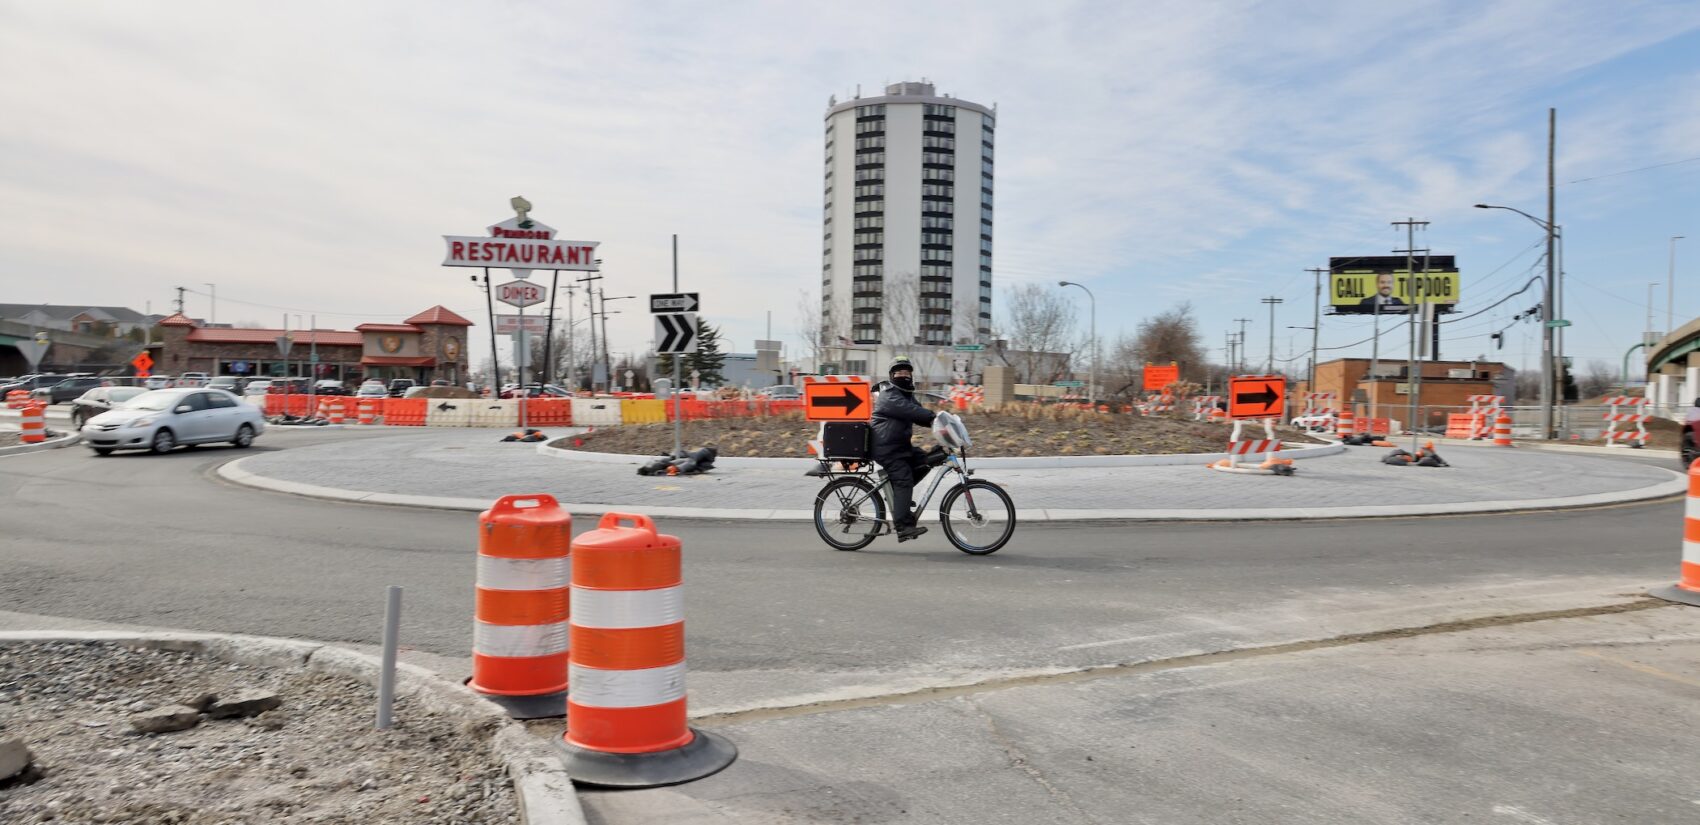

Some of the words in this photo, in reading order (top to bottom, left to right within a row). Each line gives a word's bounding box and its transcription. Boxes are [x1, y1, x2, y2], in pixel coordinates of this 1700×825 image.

[452, 241, 593, 265] RESTAURANT
[503, 286, 539, 300] DINER
[1337, 278, 1365, 298] CALL
[655, 299, 669, 307] ONE
[671, 299, 685, 307] WAY
